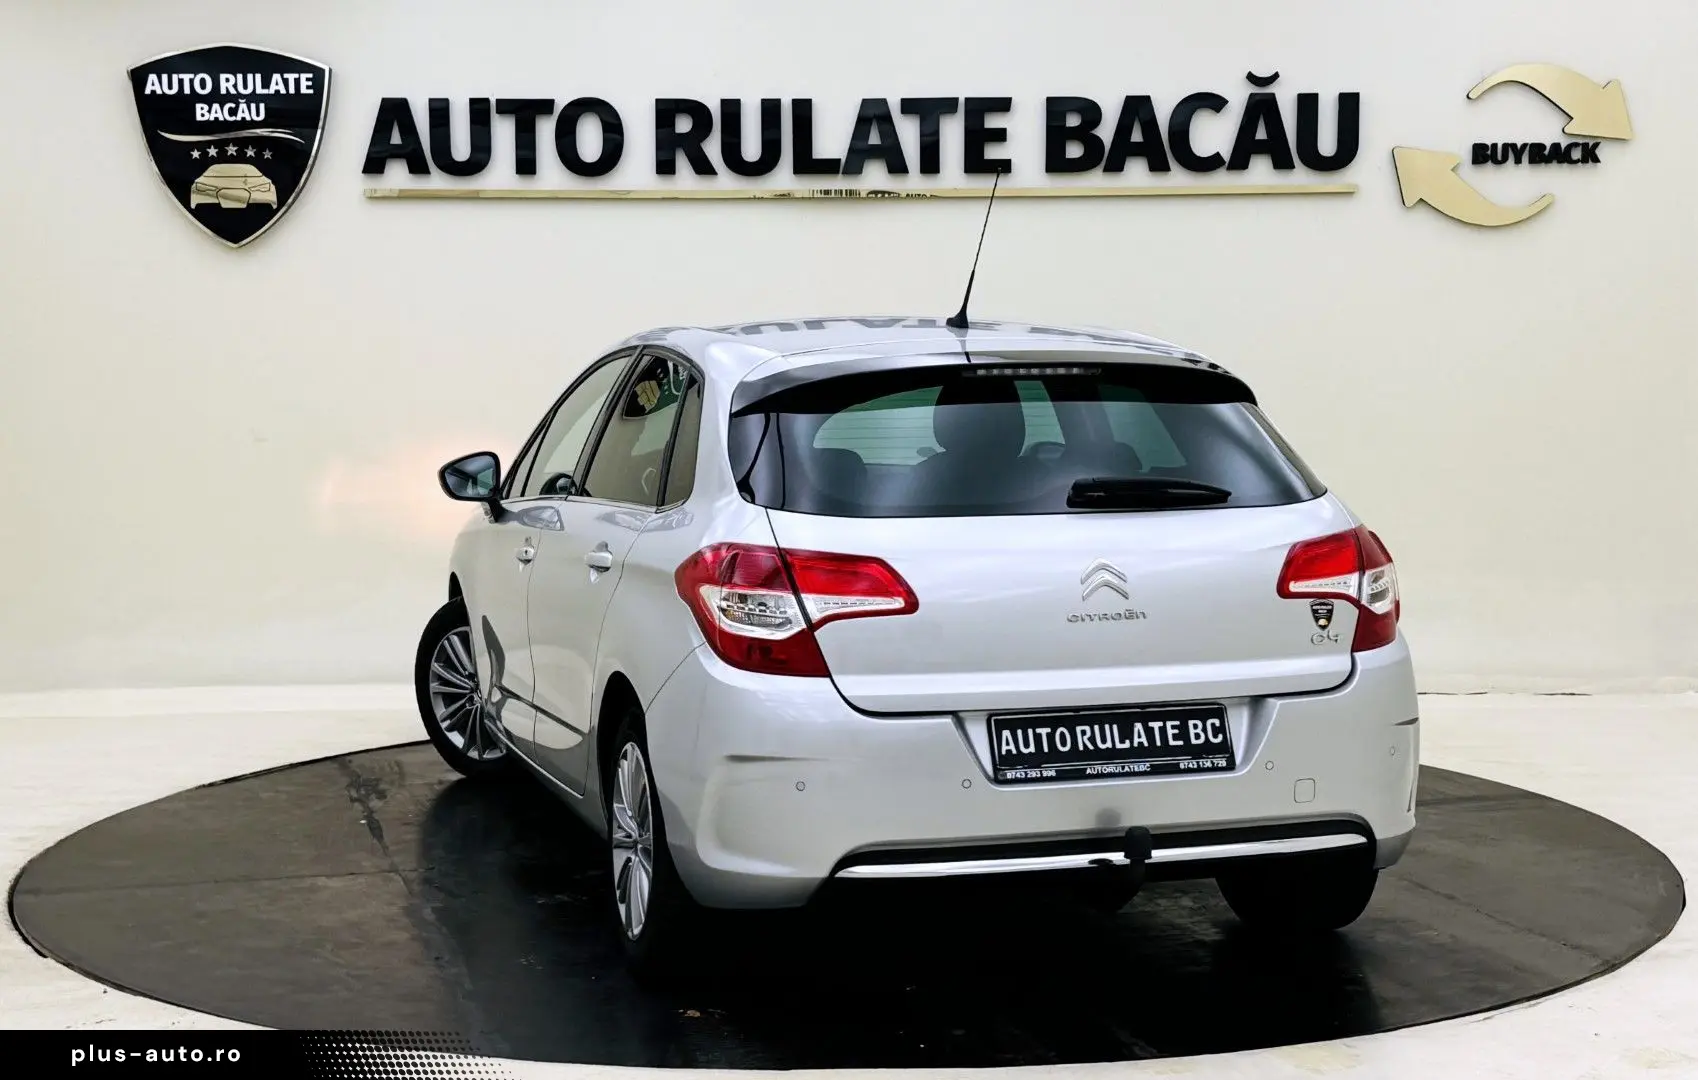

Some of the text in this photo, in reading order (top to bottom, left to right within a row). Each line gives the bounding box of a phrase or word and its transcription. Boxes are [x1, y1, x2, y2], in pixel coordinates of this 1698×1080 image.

[144, 73, 314, 95] AUTO RULATE
[195, 99, 266, 121] BACĂU
[361, 71, 1361, 177] AUTO RULATE BACĂU
[1471, 141, 1602, 165] BUYBACK
[1001, 718, 1224, 755] AUTO RULATE BC
